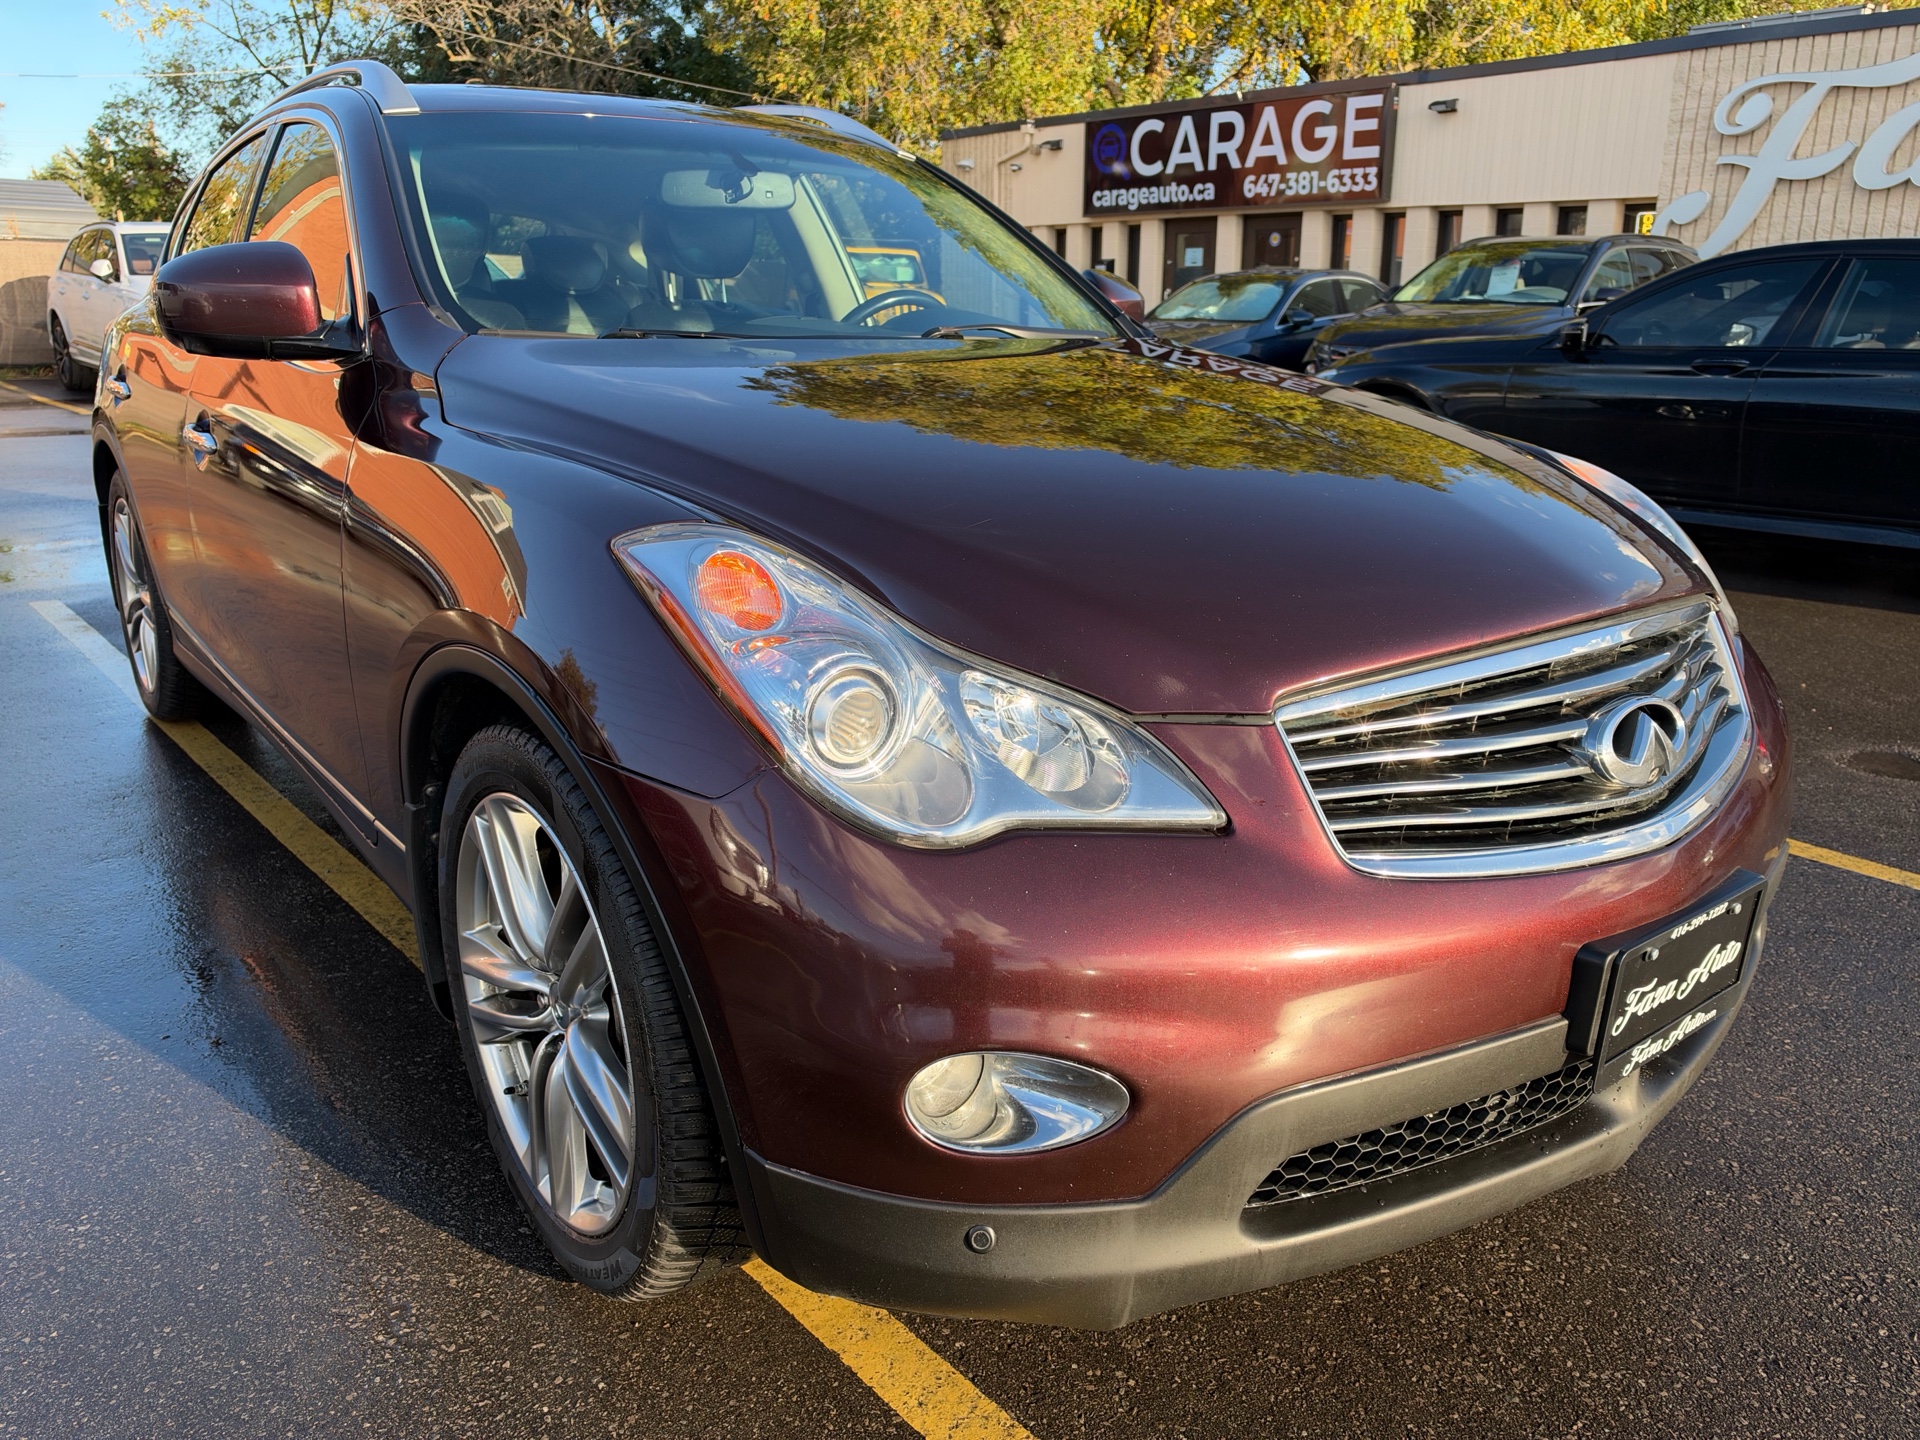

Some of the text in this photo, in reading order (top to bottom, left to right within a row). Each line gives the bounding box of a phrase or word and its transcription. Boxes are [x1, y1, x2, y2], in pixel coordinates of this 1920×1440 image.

[1131, 94, 1384, 177] CARAGE
[1092, 181, 1215, 210] carageauto.ca
[1243, 166, 1378, 198] 647-381-6333
[1677, 940, 1742, 1000] Auto
